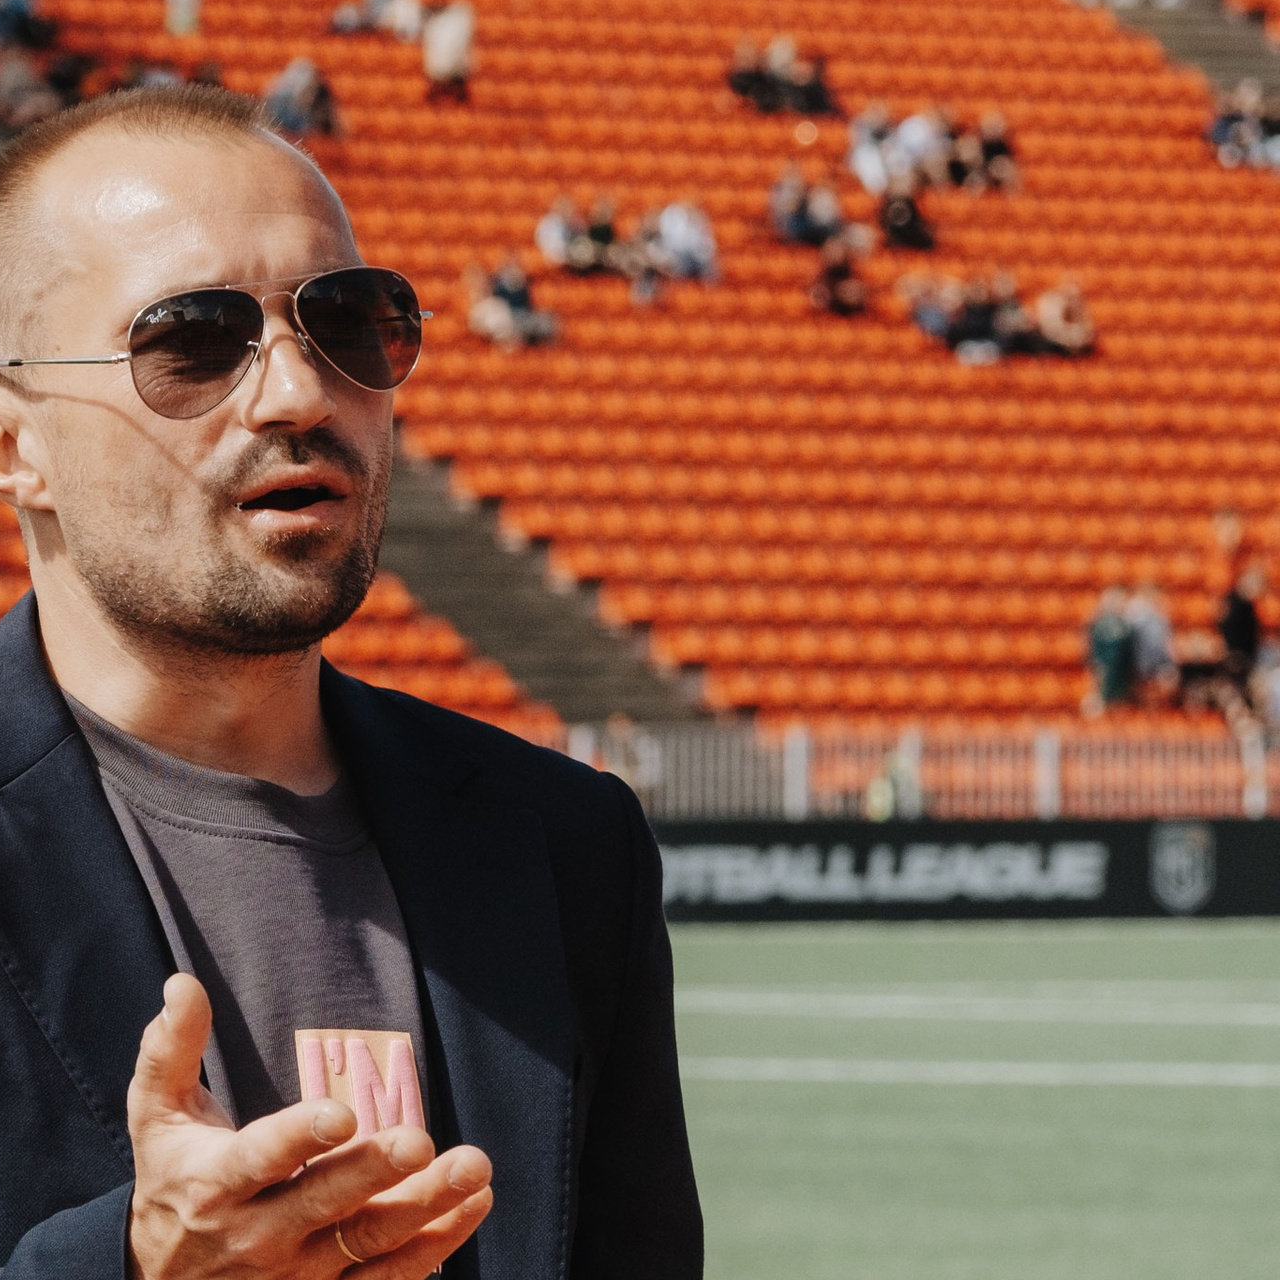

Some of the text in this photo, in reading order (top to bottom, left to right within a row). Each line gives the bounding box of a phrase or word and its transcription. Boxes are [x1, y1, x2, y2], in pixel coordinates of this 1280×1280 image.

[658, 841, 1109, 905] TBALL LEAGUE
[302, 1038, 426, 1142] I'M
